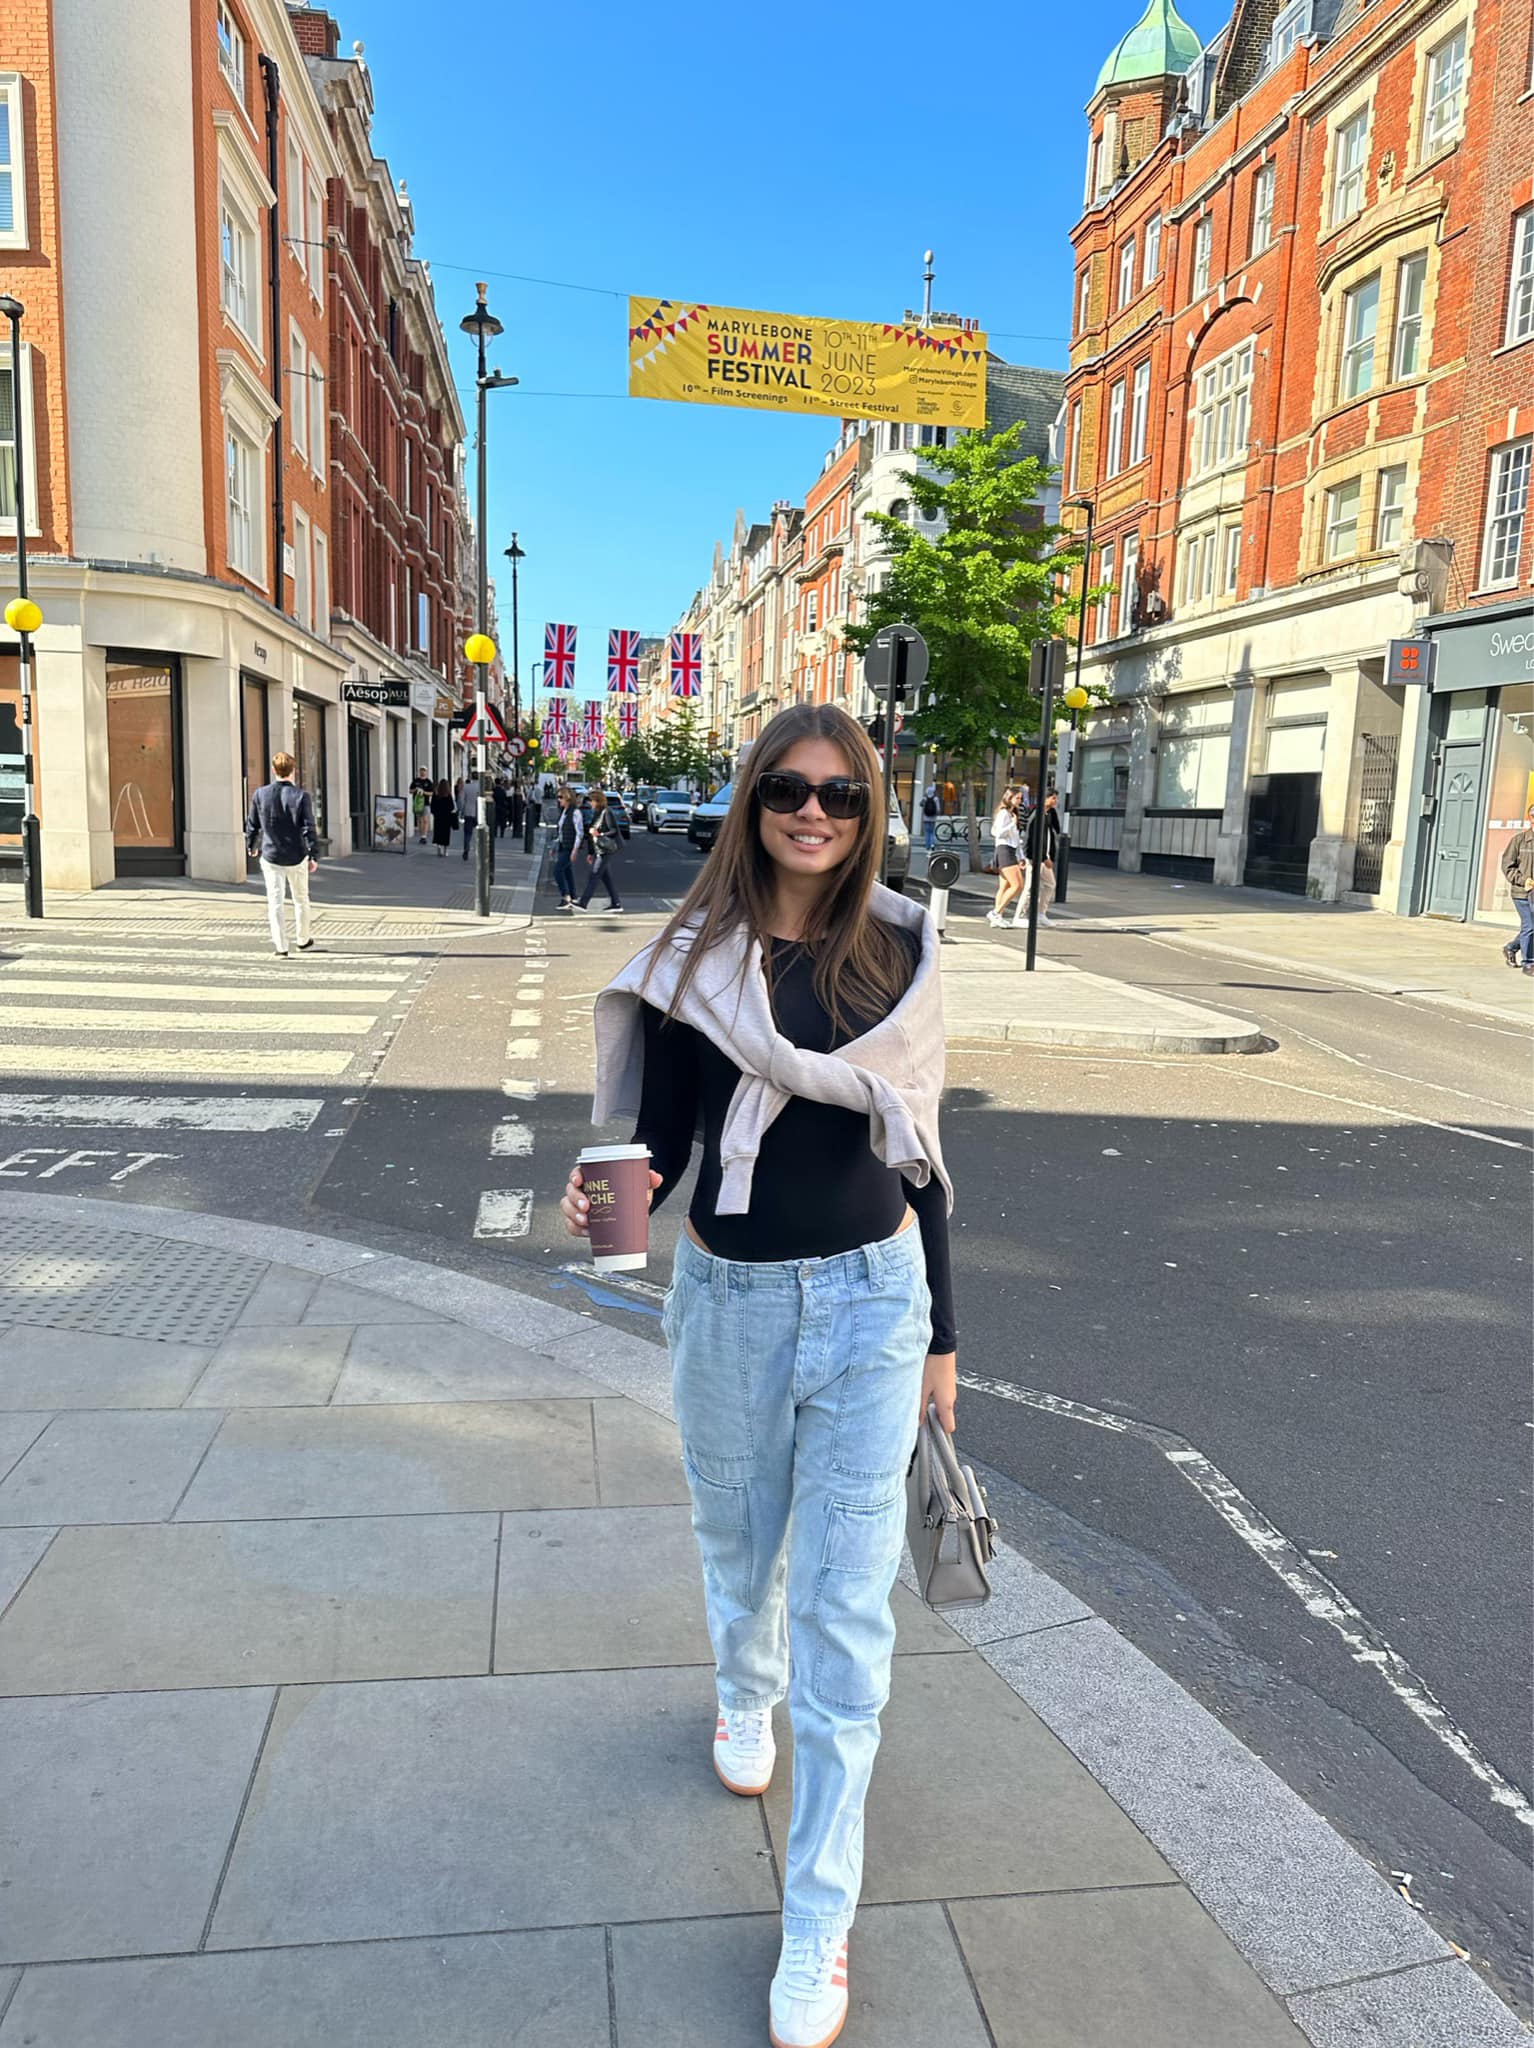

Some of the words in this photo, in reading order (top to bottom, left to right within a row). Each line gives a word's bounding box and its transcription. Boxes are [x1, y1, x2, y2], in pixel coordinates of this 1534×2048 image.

[707, 319, 813, 341] MARYLEBONE
[707, 333, 812, 365] SUMMER
[707, 358, 812, 389] FESTIVAL
[822, 352, 877, 375] JUNE
[712, 386, 733, 397] Film
[736, 390, 788, 403] Screenings
[821, 373, 877, 396] 2023
[829, 398, 860, 411] Street
[862, 402, 899, 414] Festival
[589, 1192, 616, 1205] CHE
